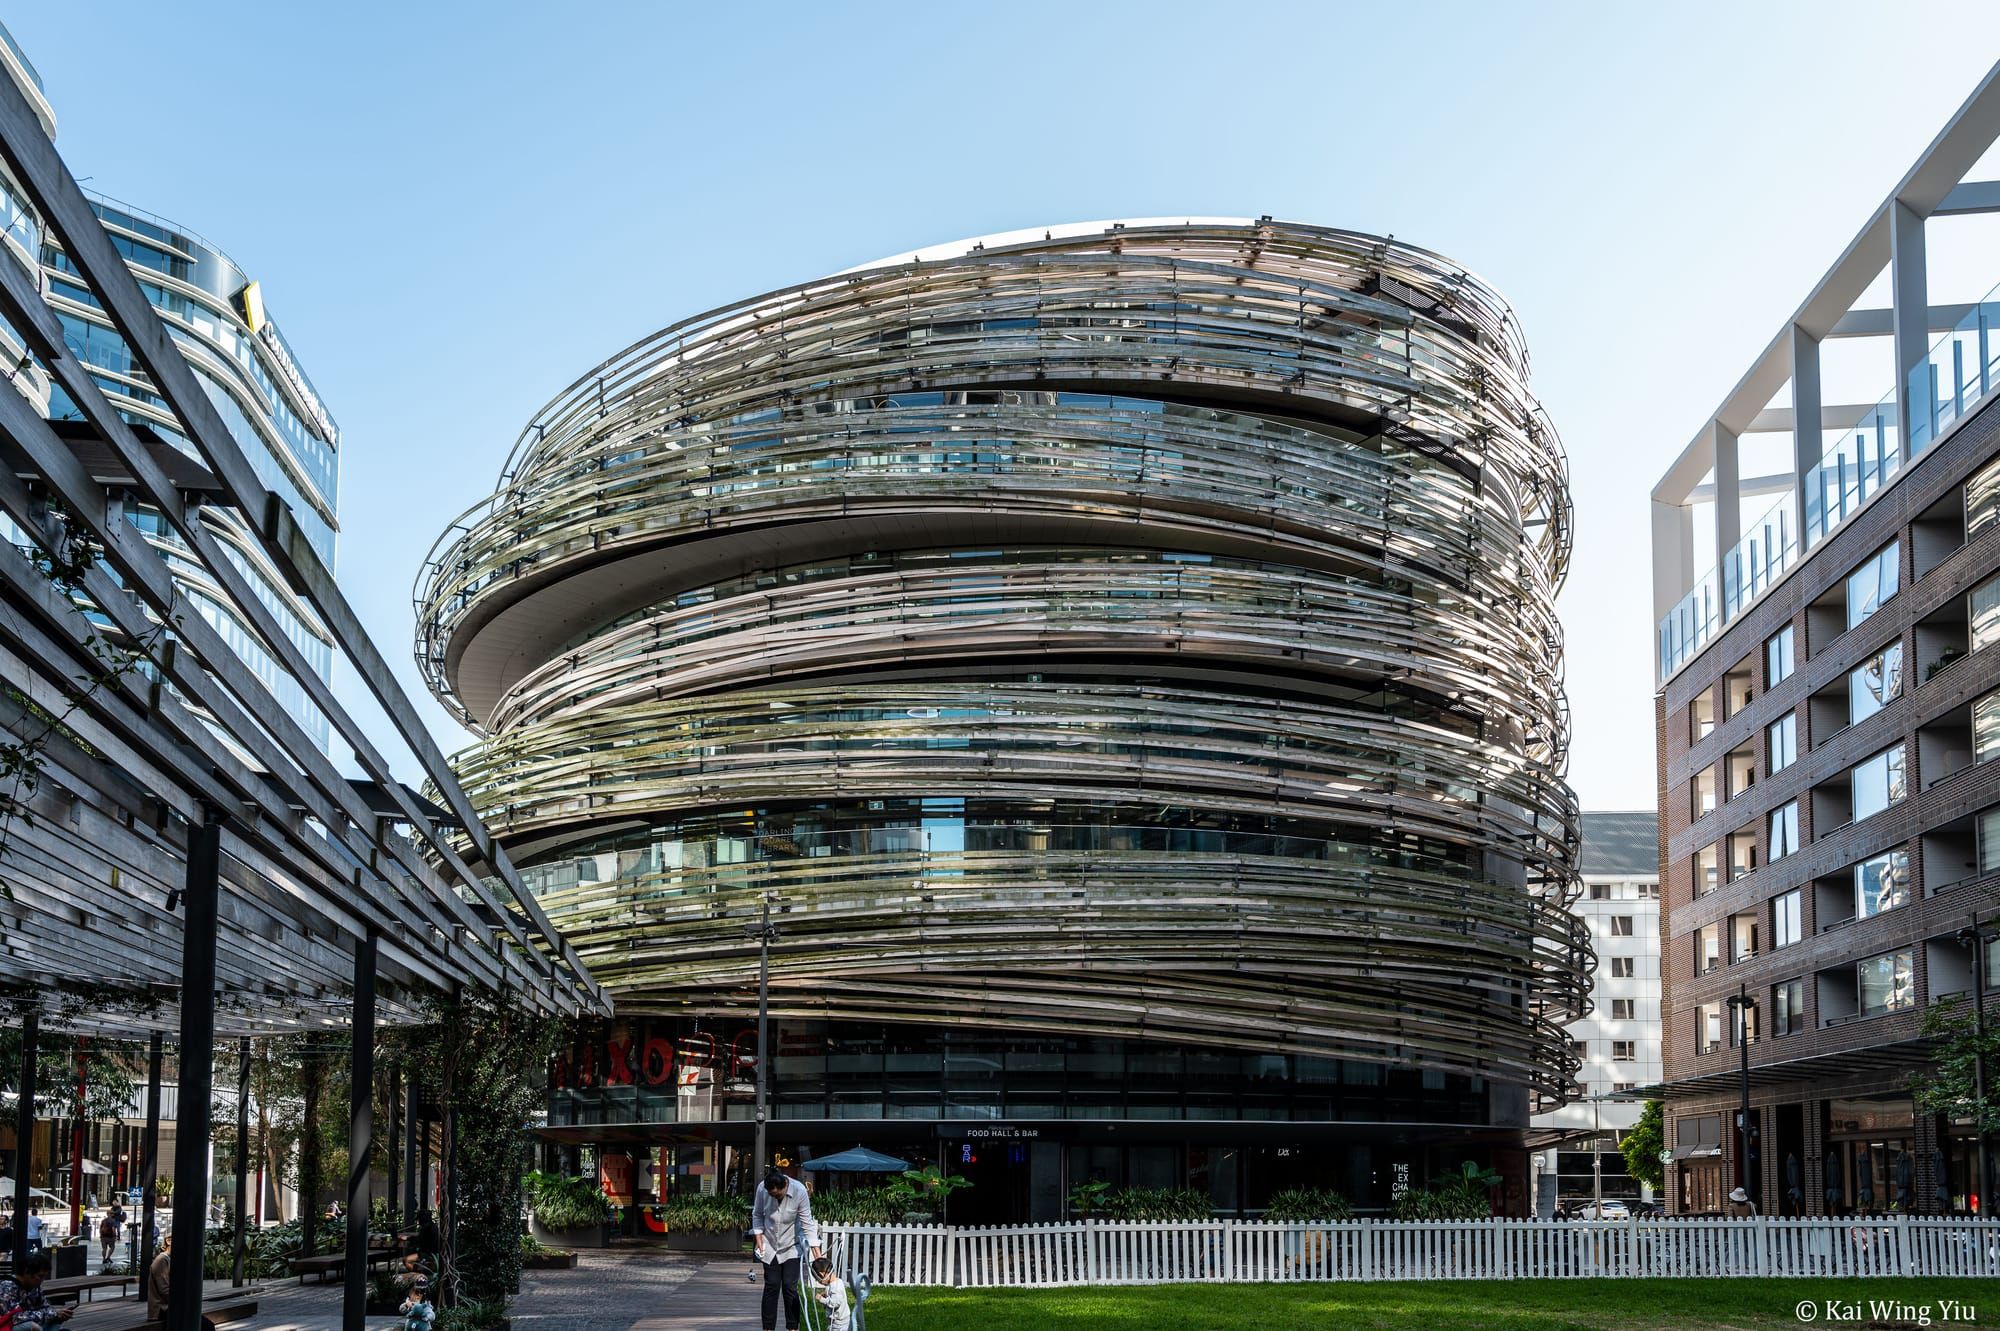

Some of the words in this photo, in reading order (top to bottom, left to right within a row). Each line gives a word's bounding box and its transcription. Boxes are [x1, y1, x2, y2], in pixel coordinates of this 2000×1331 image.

[319, 406, 337, 447] Bank
[967, 1129, 990, 1137] FOOD
[991, 1129, 1012, 1137] HALL
[1014, 1129, 1020, 1137] &
[1022, 1129, 1038, 1137] BAR
[1392, 1163, 1409, 1173] THE
[1397, 1173, 1409, 1182] EX
[1392, 1182, 1409, 1191] CHA
